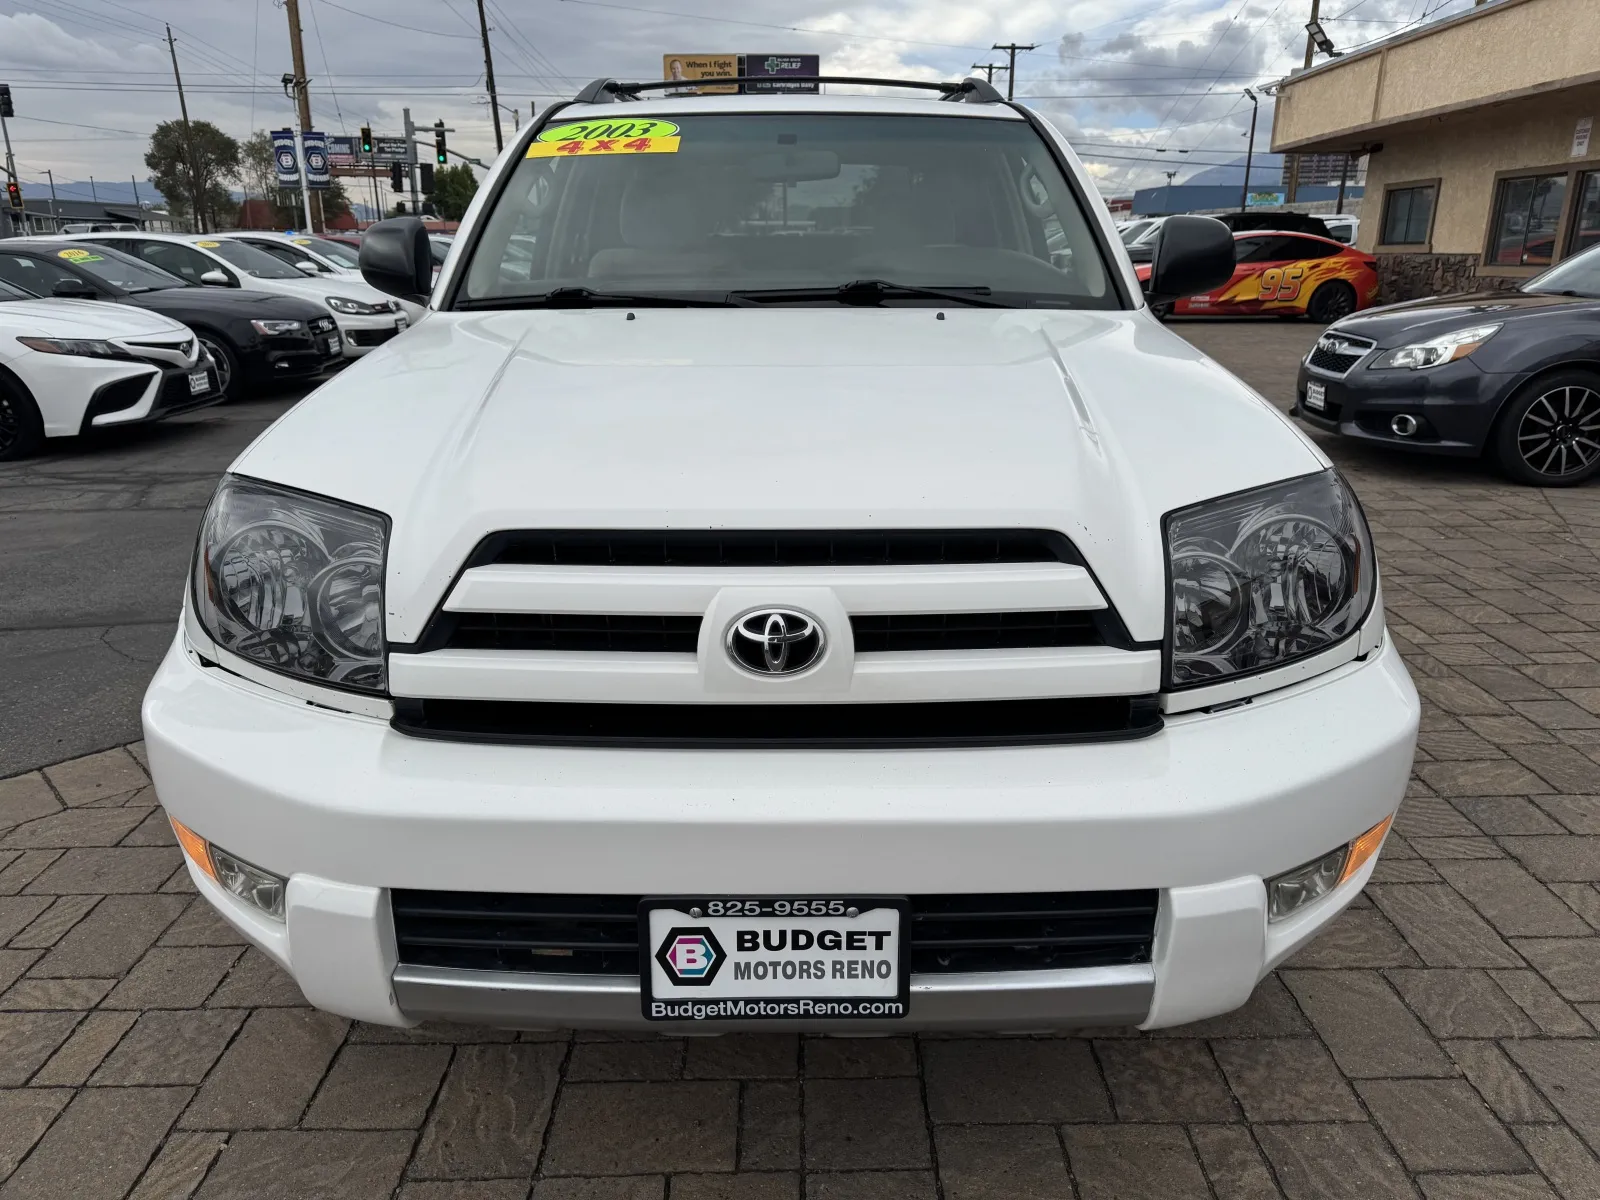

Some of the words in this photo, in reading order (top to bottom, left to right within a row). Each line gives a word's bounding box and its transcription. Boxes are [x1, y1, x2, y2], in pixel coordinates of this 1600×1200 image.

[713, 60, 732, 71] fight
[716, 69, 733, 77] win.
[556, 122, 658, 141] 2003
[328, 144, 350, 153] COMING
[1258, 268, 1303, 301] 95
[708, 901, 845, 916] 825-9555
[736, 929, 892, 952] BUDGET
[676, 943, 708, 970] B
[734, 960, 826, 981] MOTORS
[831, 960, 892, 980] RENO
[651, 1000, 903, 1019] BudgetMotorsReno.com
